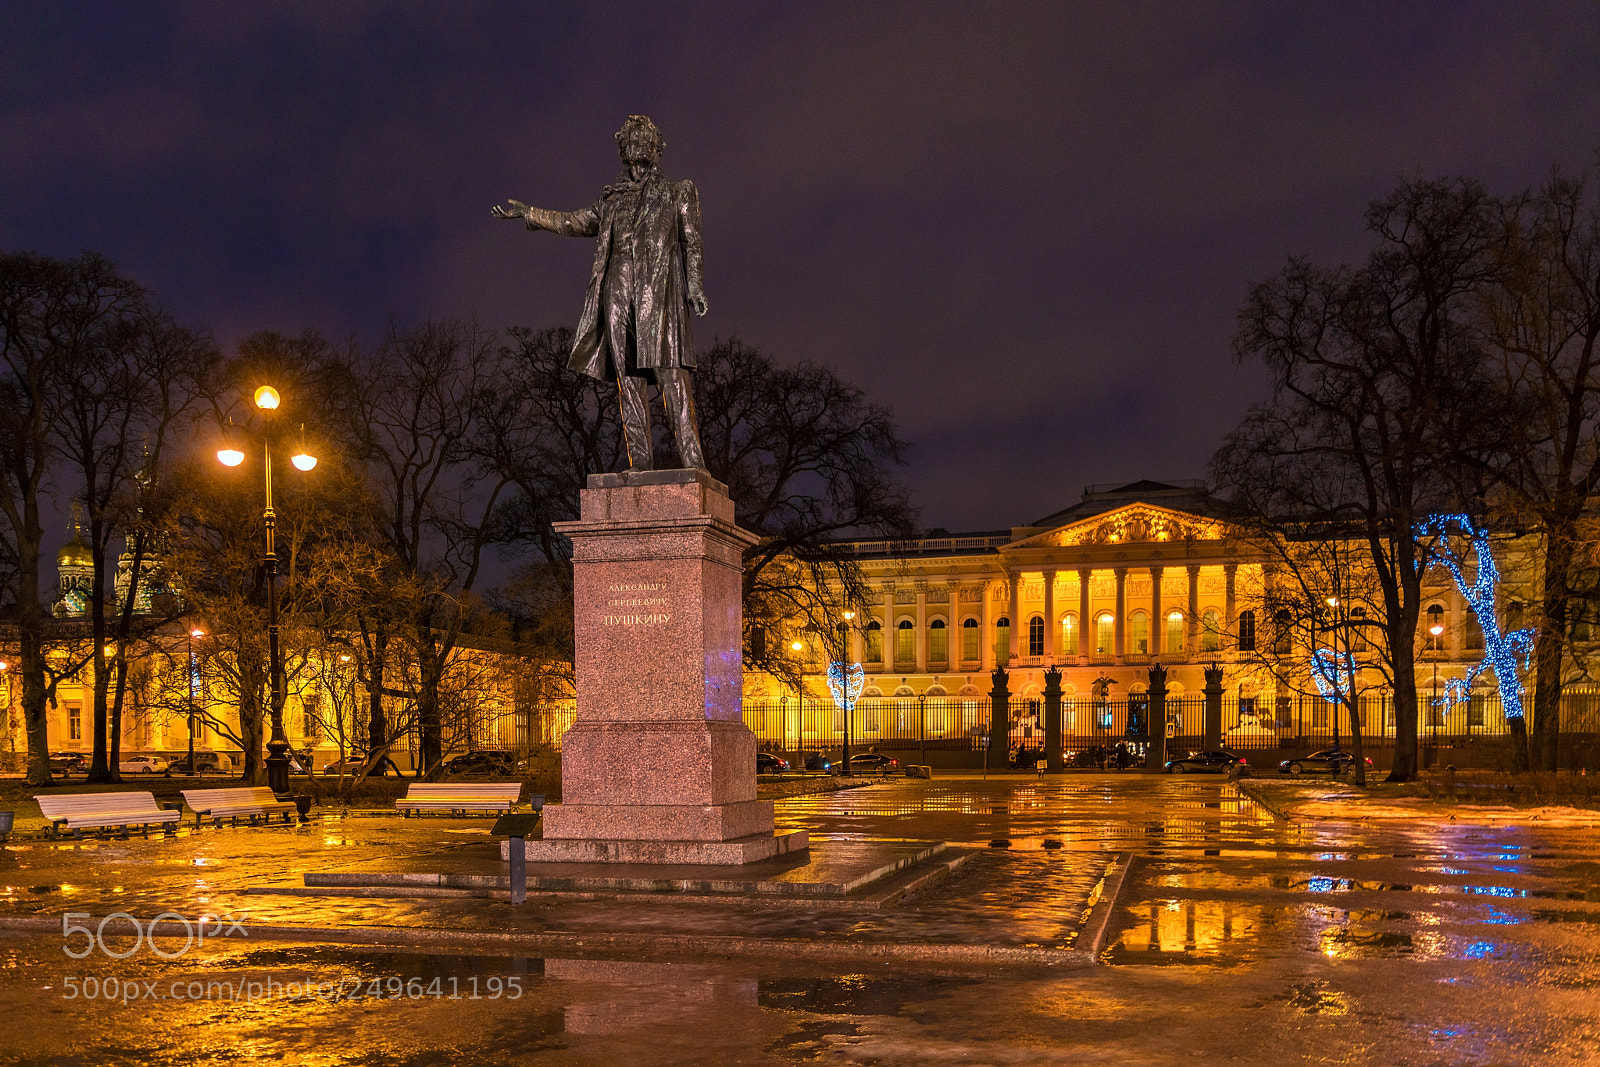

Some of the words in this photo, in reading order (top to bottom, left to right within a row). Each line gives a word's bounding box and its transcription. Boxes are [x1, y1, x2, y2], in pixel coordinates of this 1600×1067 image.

[607, 582, 668, 592] АЛЕКСАНДРУ
[607, 597, 668, 606] СЕРГЕЕВИЧУ
[604, 613, 671, 625] ПУШКИНУ
